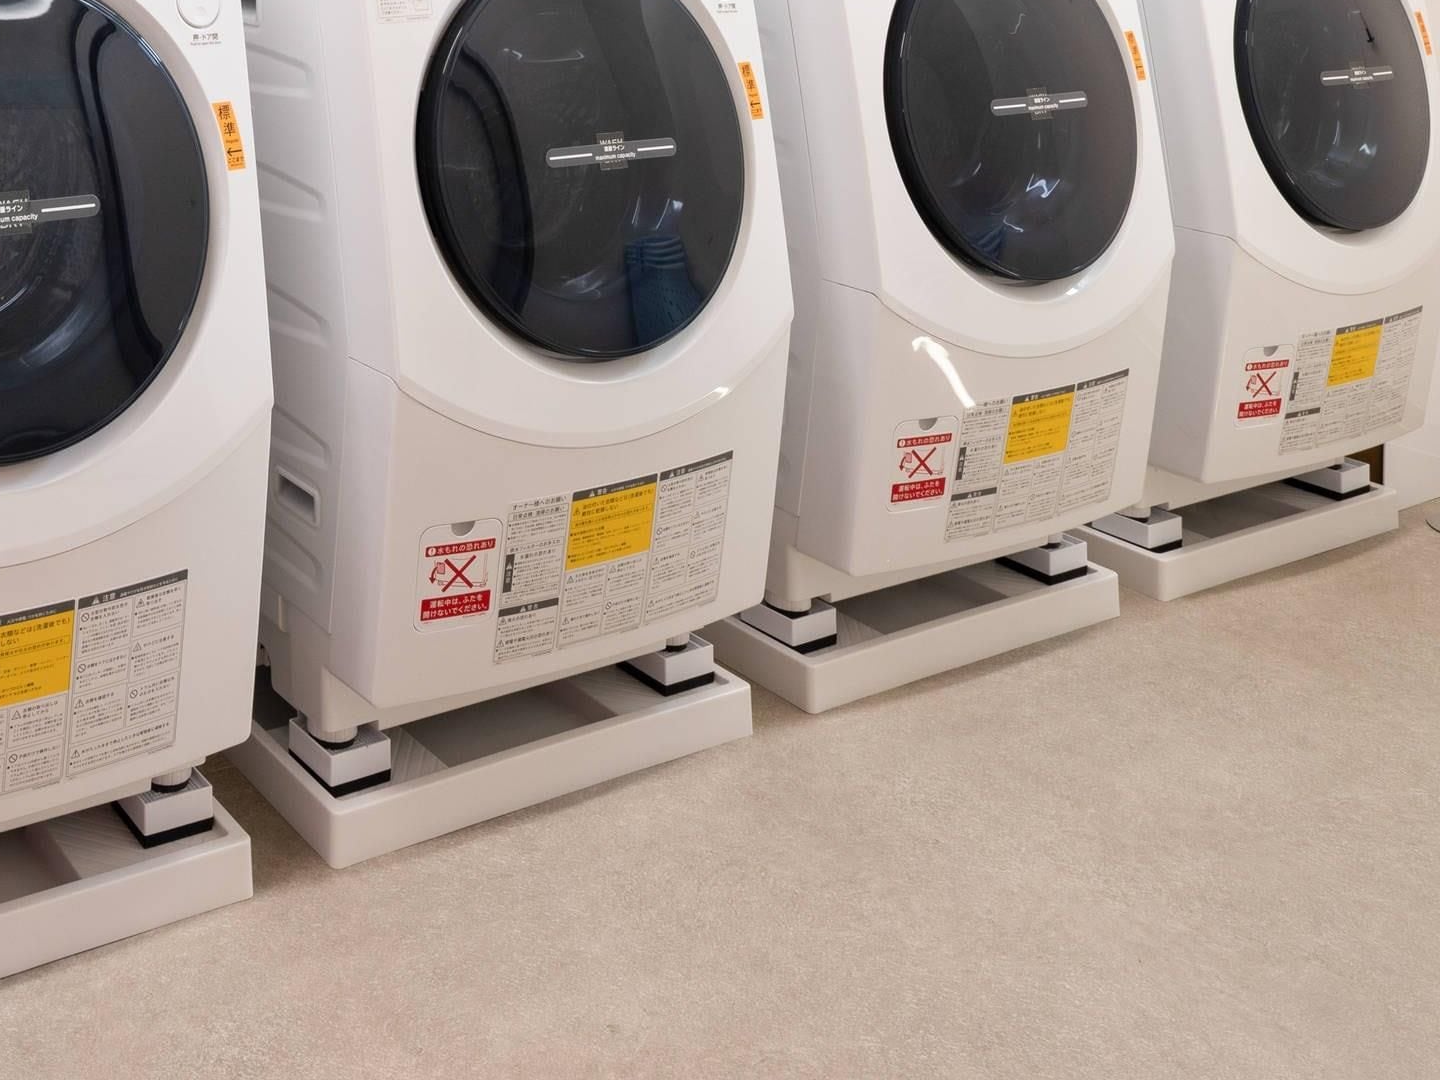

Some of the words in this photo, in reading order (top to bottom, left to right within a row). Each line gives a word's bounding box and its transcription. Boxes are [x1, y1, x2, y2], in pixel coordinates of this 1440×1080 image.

[218, 104, 236, 136] 標準
[11, 213, 38, 222] capacity
[437, 540, 493, 555] 水もれの恐れあり
[430, 594, 483, 608] 運転中は、ふたを
